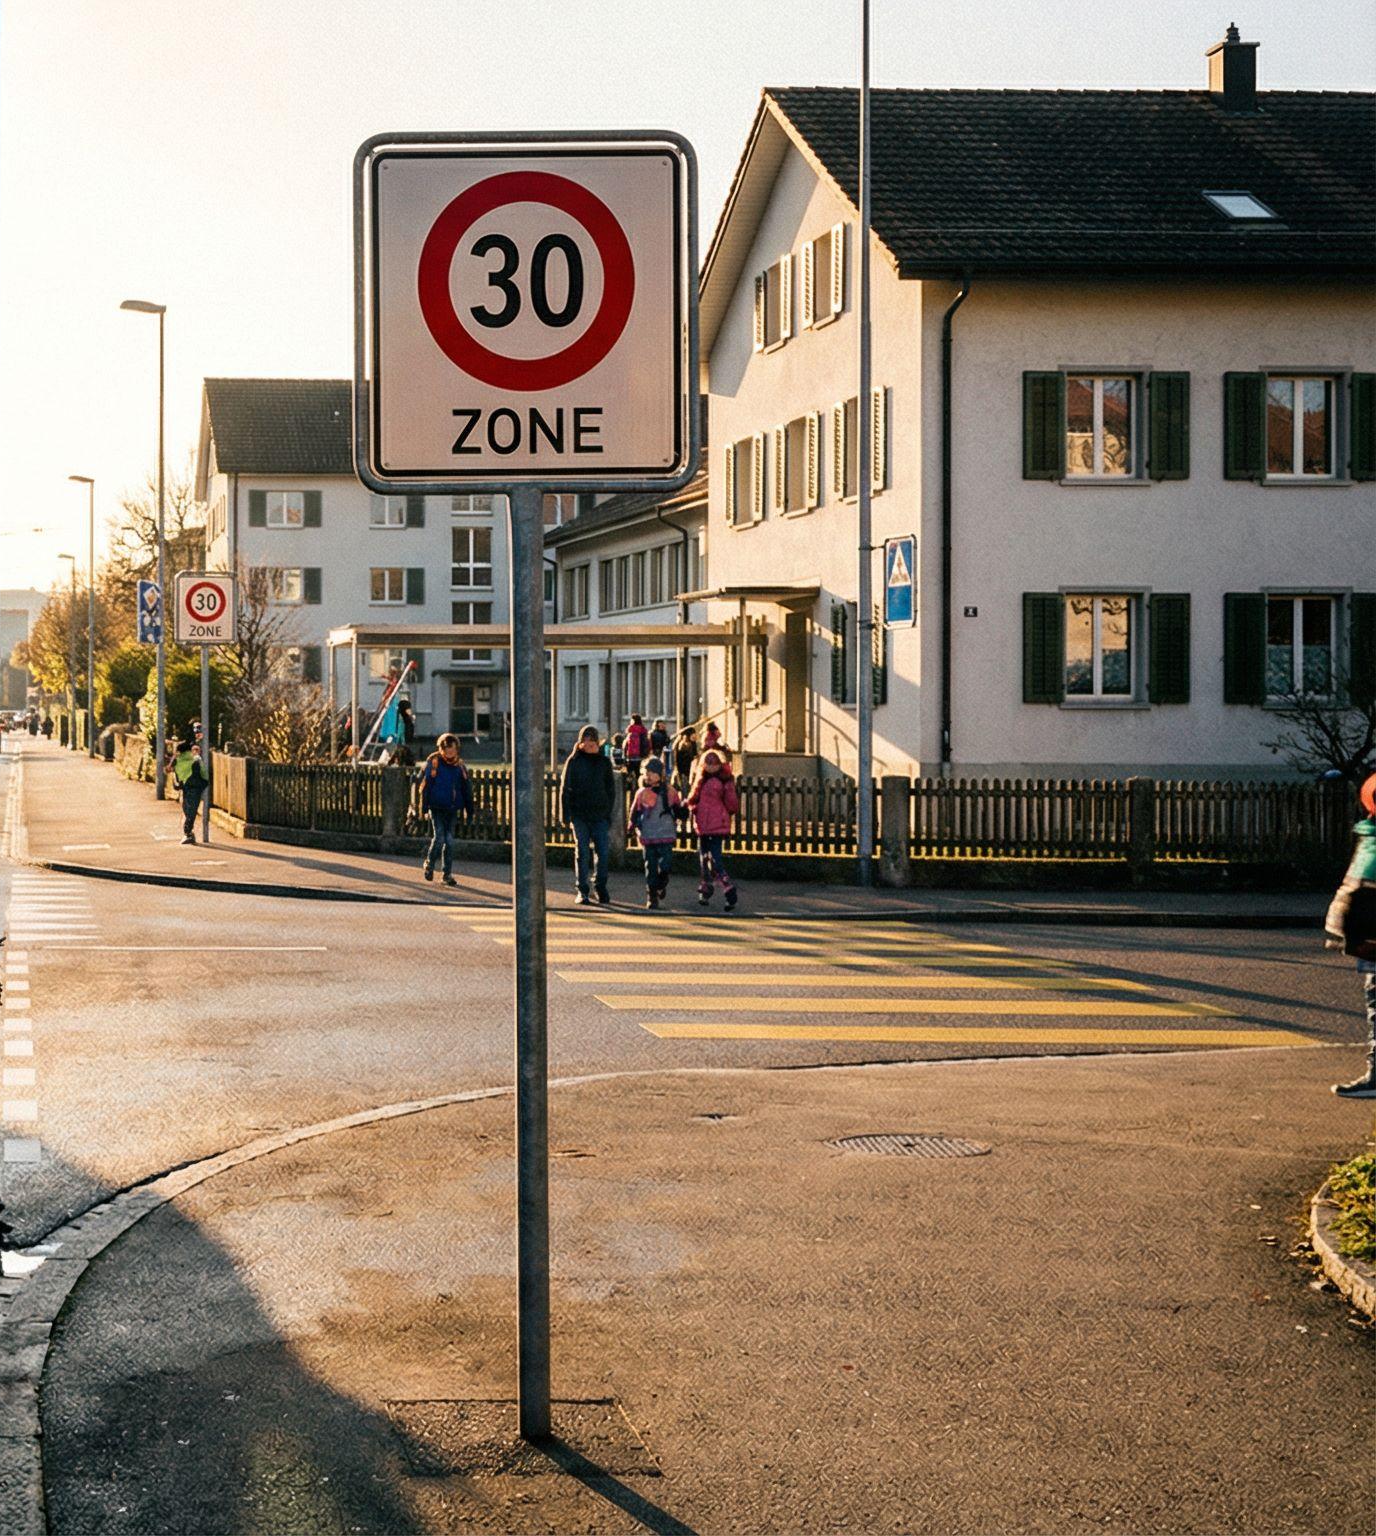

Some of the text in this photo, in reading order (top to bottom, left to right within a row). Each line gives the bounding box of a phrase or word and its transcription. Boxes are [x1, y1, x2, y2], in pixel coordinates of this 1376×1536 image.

[470, 233, 584, 328] 30
[452, 407, 604, 454] ZONE
[195, 593, 217, 610] 30
[189, 625, 222, 637] ZONE
